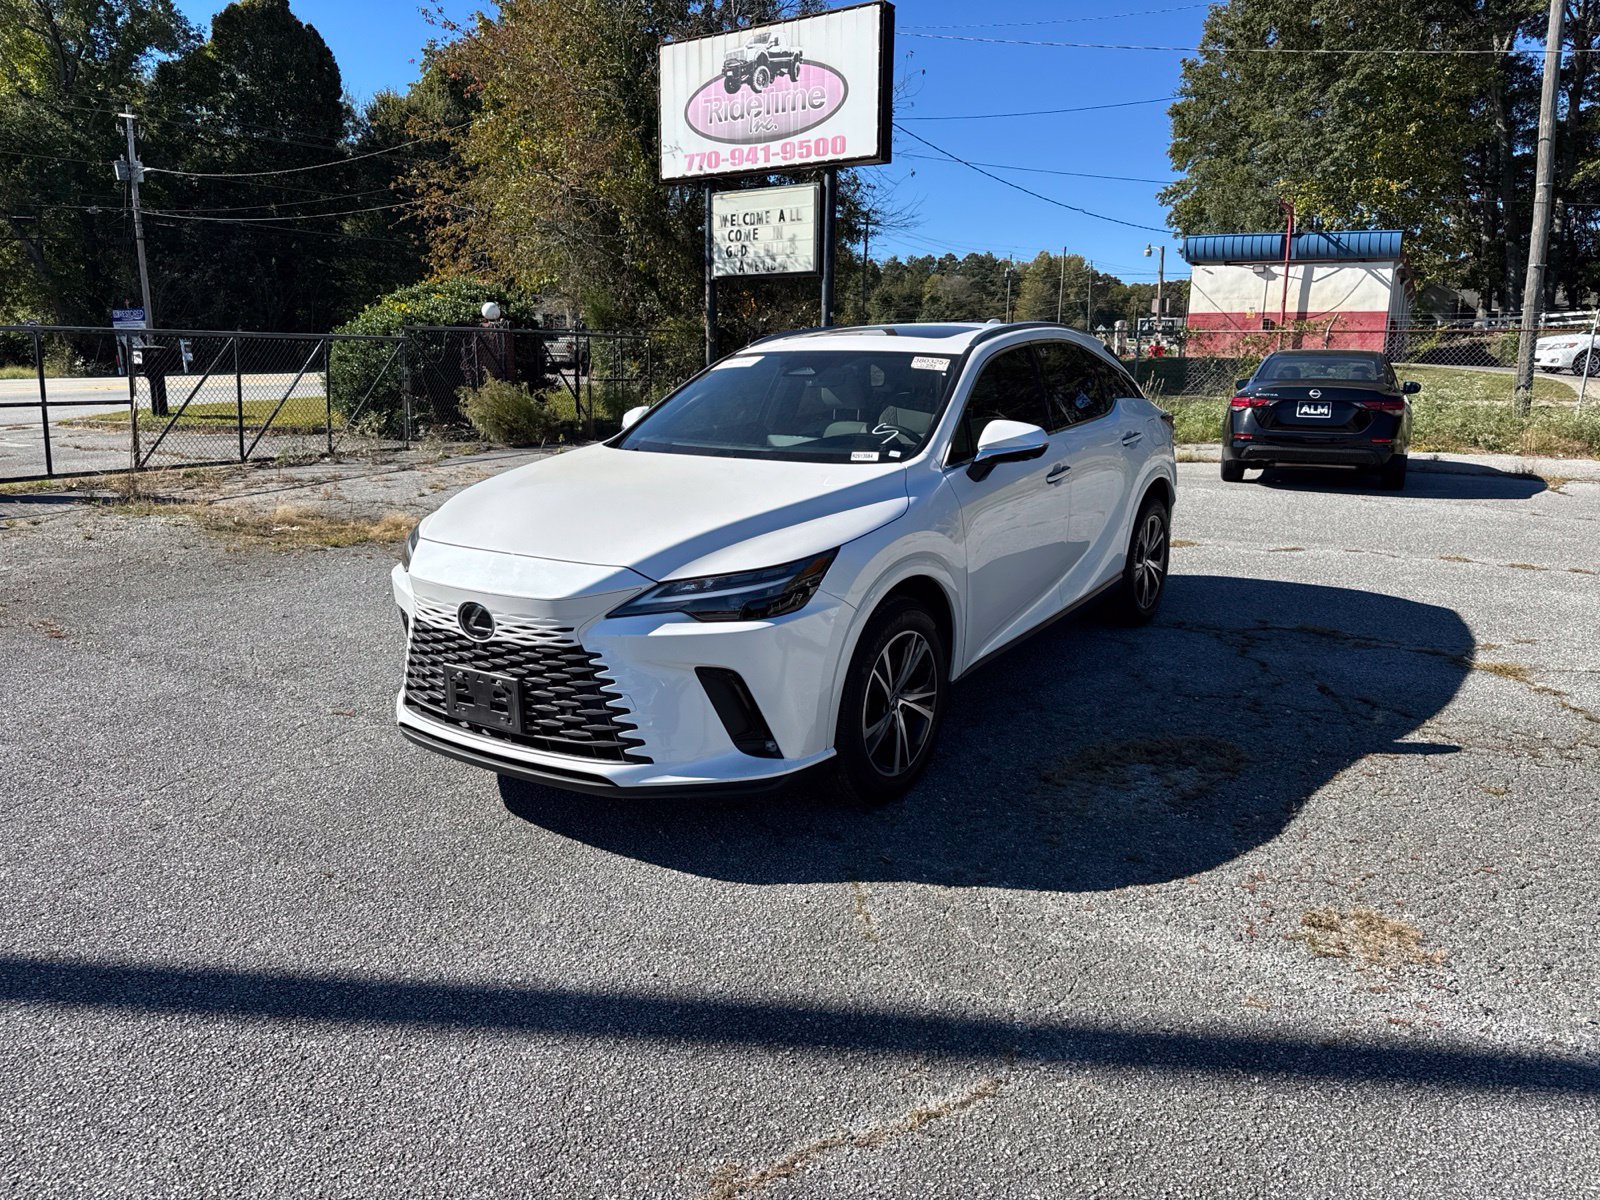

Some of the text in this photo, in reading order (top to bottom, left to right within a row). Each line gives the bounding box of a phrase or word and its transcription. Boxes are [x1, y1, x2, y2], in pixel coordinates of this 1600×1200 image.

[703, 85, 827, 125] RideTime
[749, 110, 778, 134] Inc.
[684, 135, 847, 172] 770-941-9500
[720, 208, 802, 227] WELCOME ALL
[727, 228, 759, 242] COME
[1301, 404, 1328, 414] ALM
